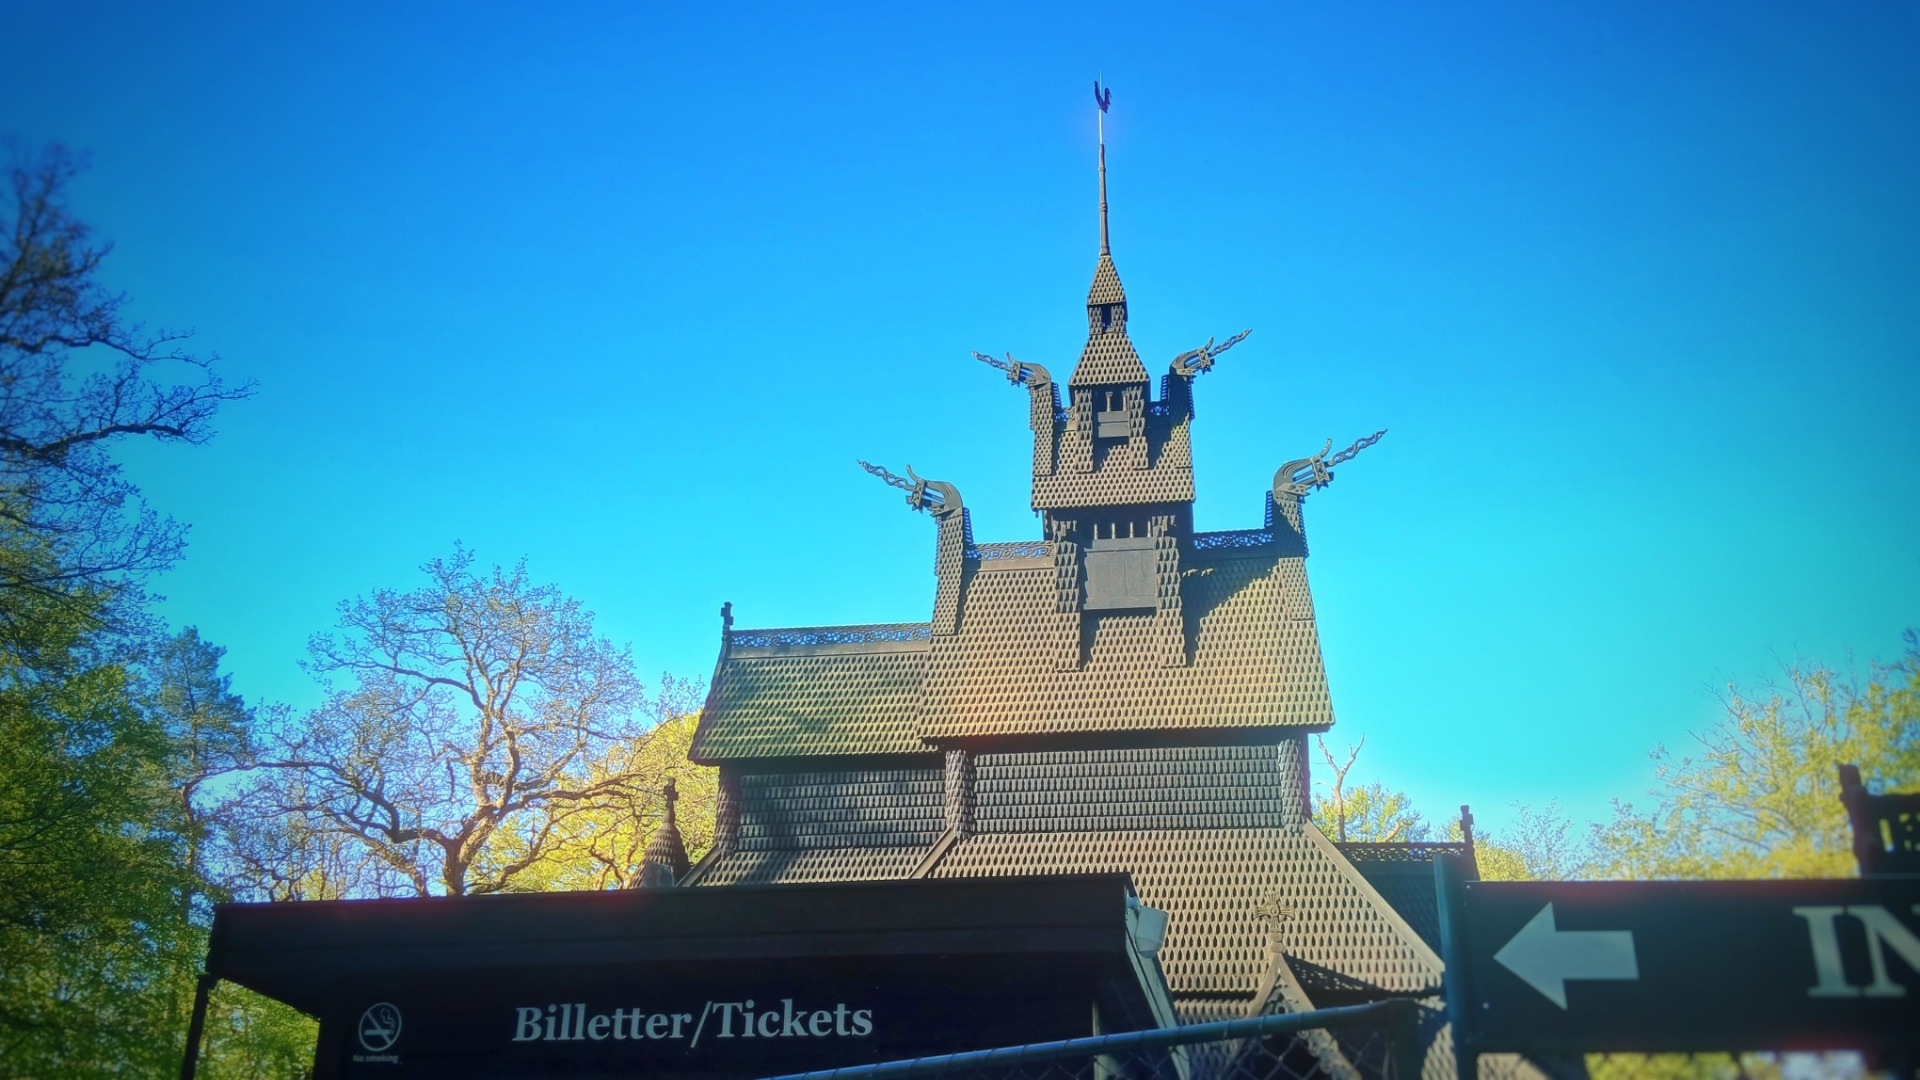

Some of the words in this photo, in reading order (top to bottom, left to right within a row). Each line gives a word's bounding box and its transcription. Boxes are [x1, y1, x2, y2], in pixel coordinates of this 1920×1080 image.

[511, 998, 873, 1048] Billetter/Tickets
[352, 1054, 365, 1063] No
[365, 1054, 399, 1064] smoking
